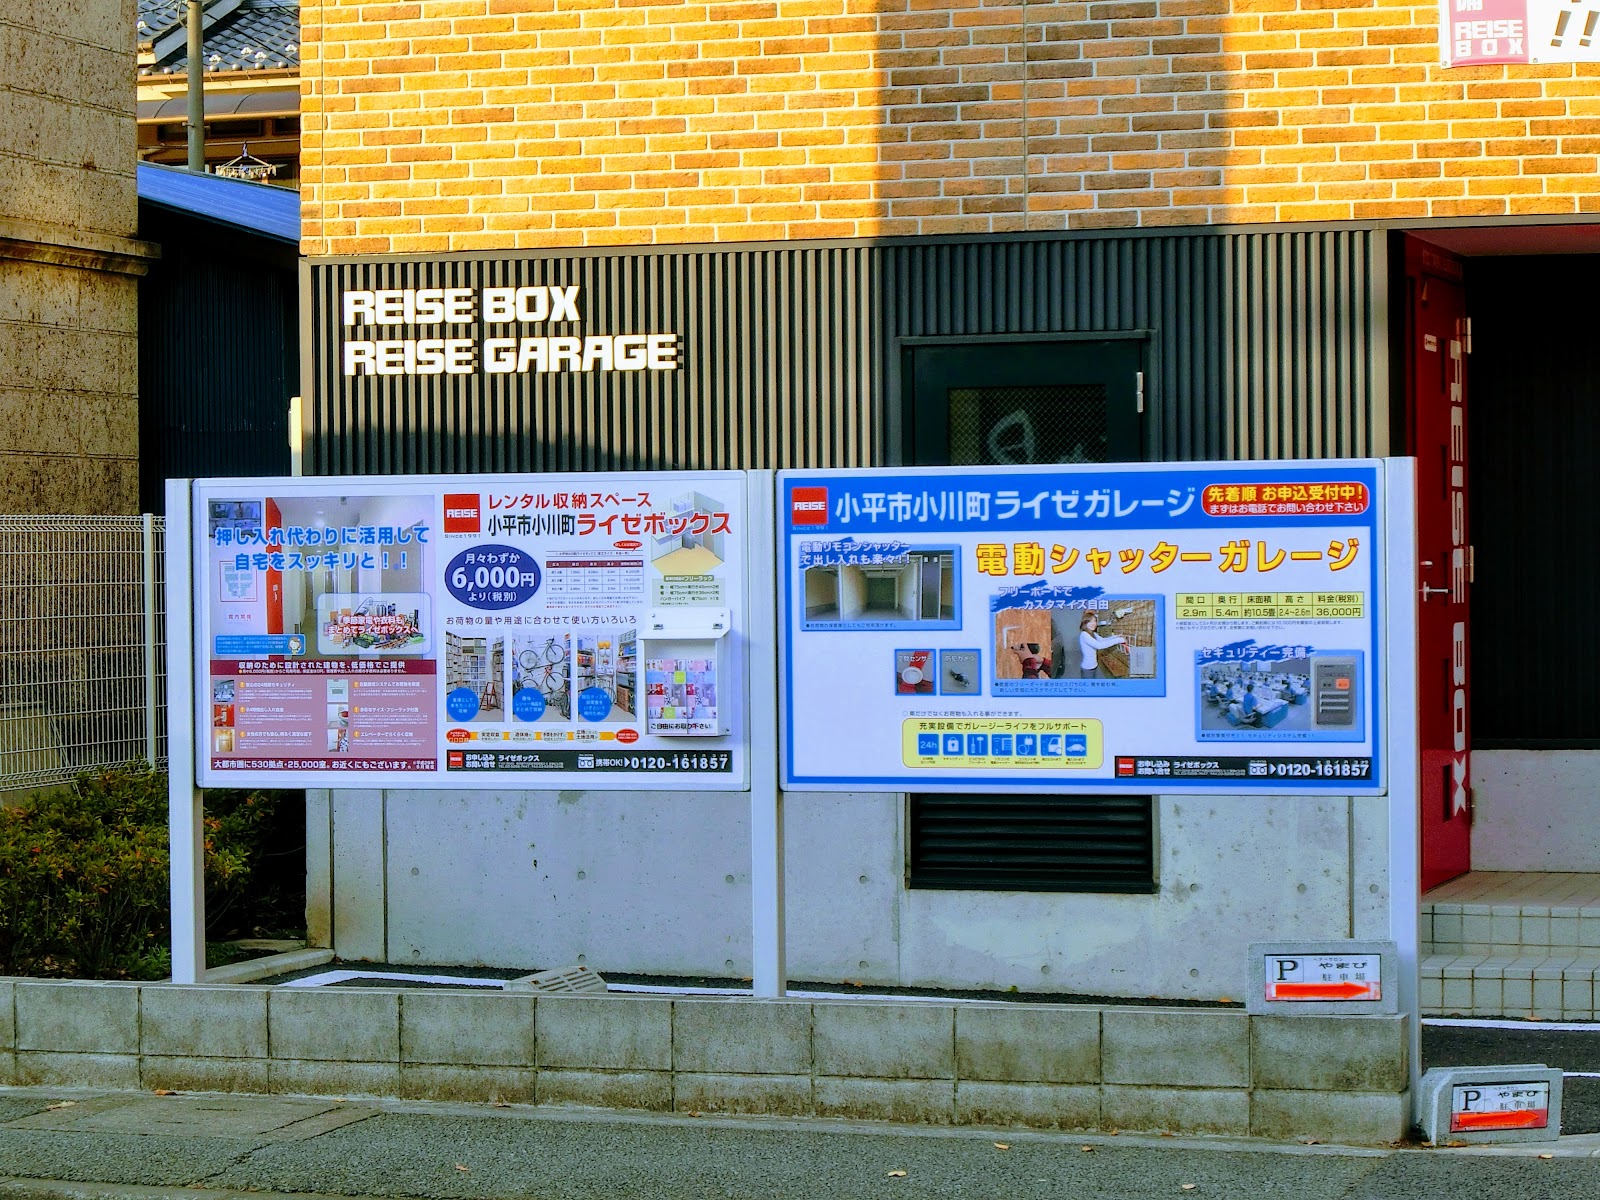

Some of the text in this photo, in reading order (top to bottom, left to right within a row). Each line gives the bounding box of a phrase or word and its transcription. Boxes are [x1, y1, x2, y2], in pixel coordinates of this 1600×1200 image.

[1455, 20, 1523, 39] REISE
[344, 285, 581, 326] REISE BOX
[344, 333, 677, 376] REISE GARAGE
[1208, 484, 1363, 502] 先着順 お申込受付中!
[489, 492, 652, 509] レンタル収納スペース
[794, 501, 826, 511] REISE
[835, 487, 1195, 524] 小平市小川町ライゼガレージ
[446, 508, 478, 518] REISE
[1209, 502, 1364, 514] まずはお電話でお問い合わせ下さい
[216, 526, 430, 547] 押し入れ代わりに活用して
[800, 540, 912, 553] 電動リモコンシャッター
[464, 553, 520, 565] 月々わずか
[976, 538, 1360, 577] 電動シャッターガレージ
[452, 567, 535, 590] 6,000円
[998, 586, 1073, 597] フリーボードで
[1023, 599, 1110, 610] カスタマイズ自由
[1246, 595, 1272, 604] 床面積
[1285, 595, 1304, 604] 高さ
[1182, 609, 1207, 617] 2.9m
[1215, 608, 1239, 617] 5.4m
[1316, 606, 1361, 617] 36,000円
[446, 615, 637, 625] お荷物の量や用途に合わせて使い方いろいろ
[1201, 647, 1306, 659] セキュリティー完備
[920, 740, 937, 749] 24h
[631, 757, 729, 769] 0120-161857
[1278, 763, 1369, 776] 0120-161857
[1277, 960, 1298, 980] P
[1322, 973, 1365, 981] 駐車場
[1462, 1090, 1481, 1111] P
